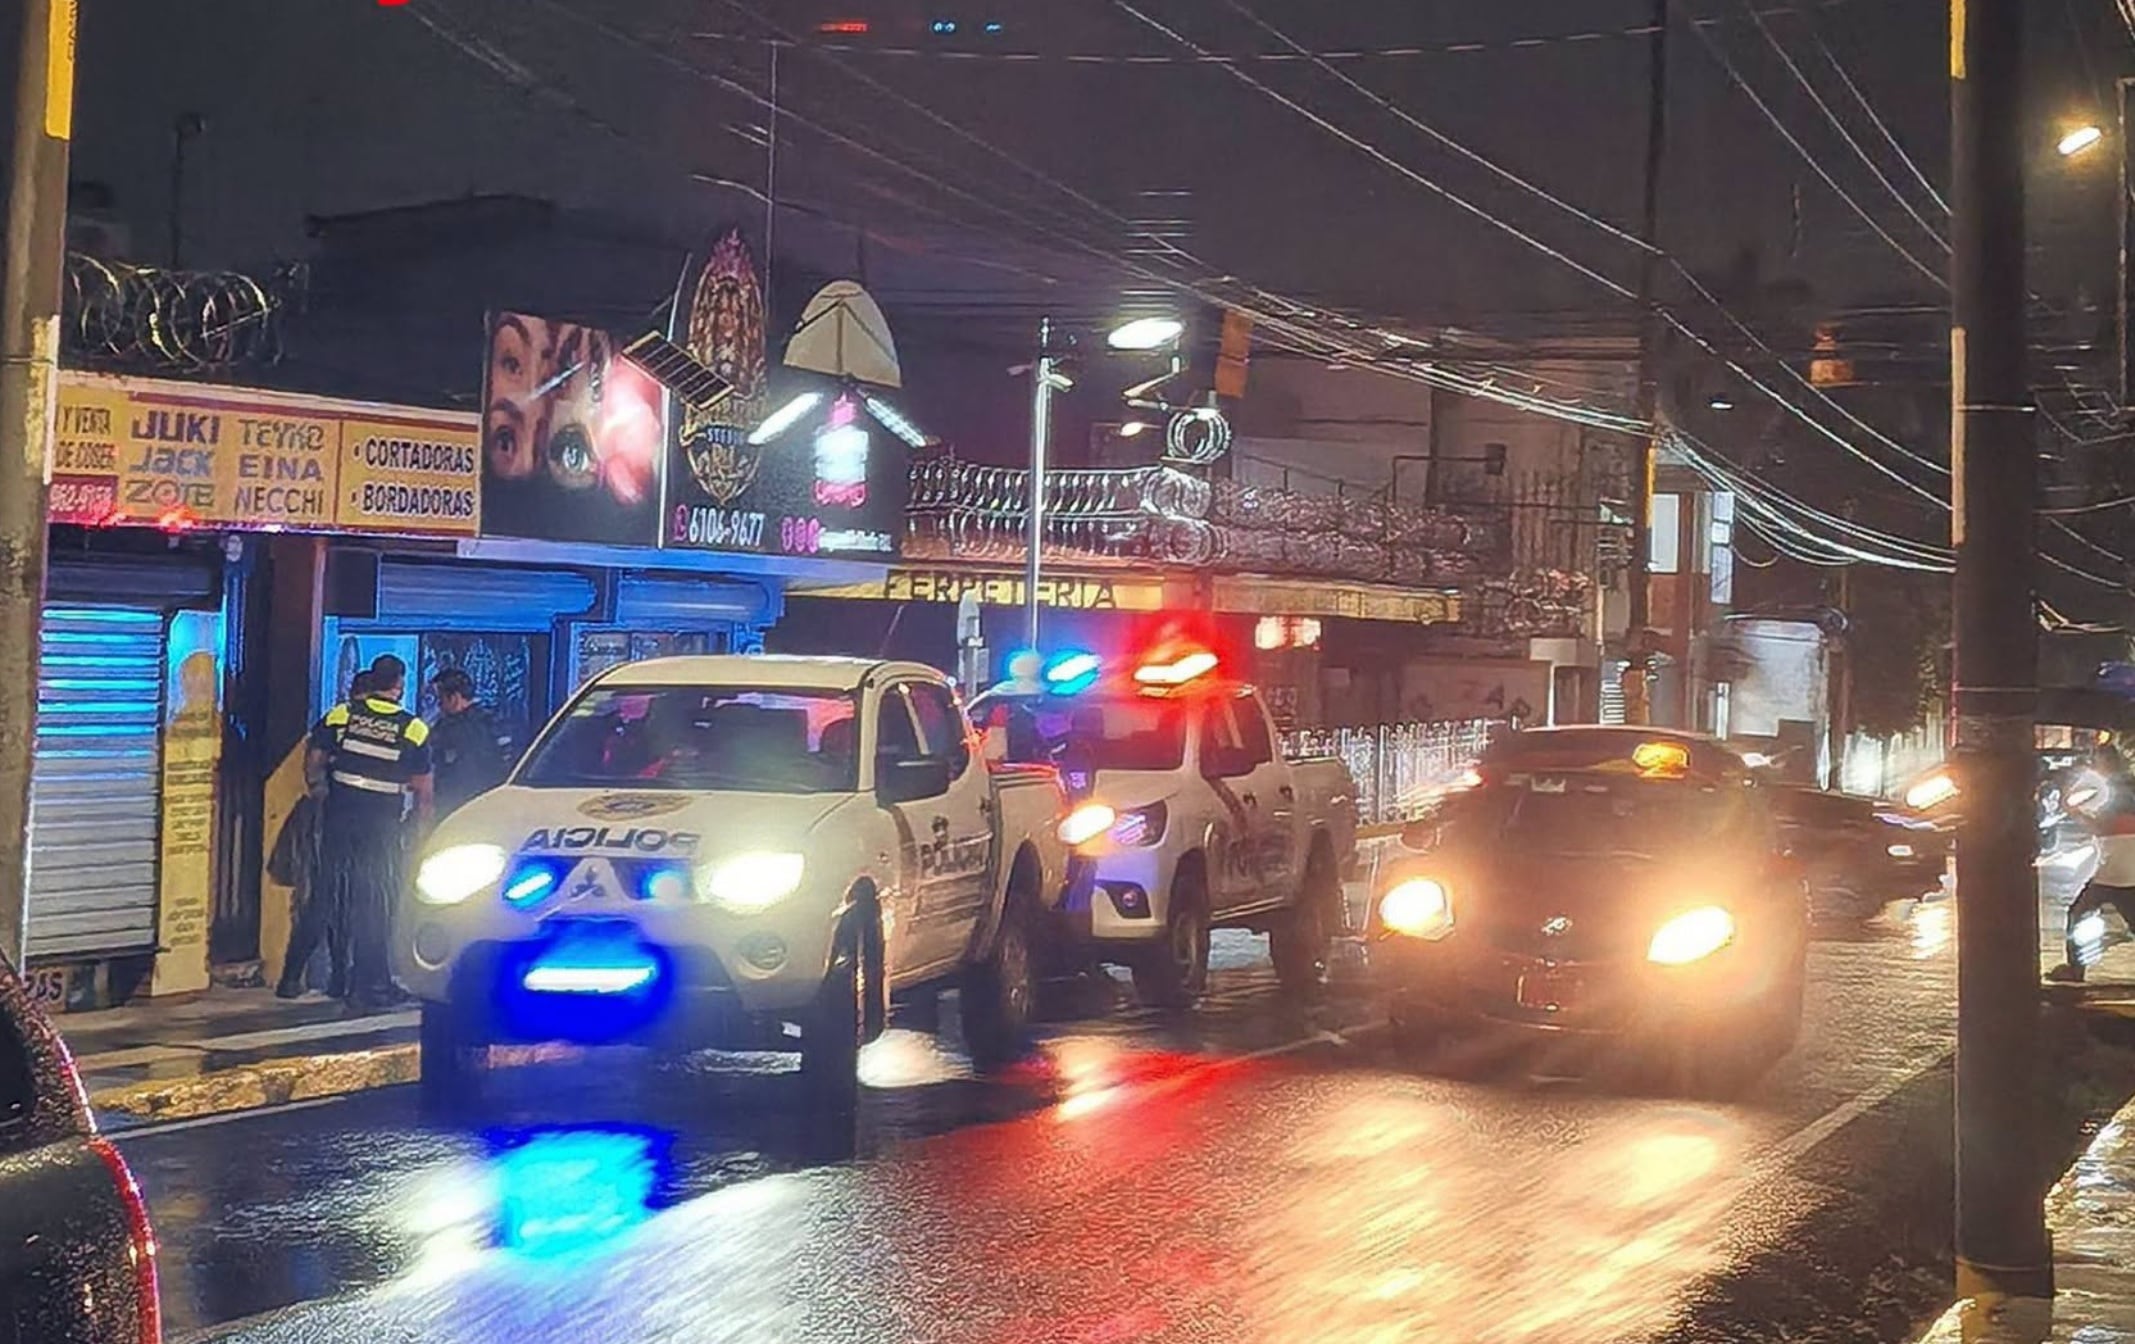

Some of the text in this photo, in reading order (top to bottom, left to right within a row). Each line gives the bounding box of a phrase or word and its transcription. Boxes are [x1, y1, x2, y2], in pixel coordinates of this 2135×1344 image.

[131, 410, 220, 444] JUKI
[239, 453, 324, 482] EINA
[365, 438, 475, 474] CORTADORAS
[234, 486, 323, 515] NECCHI
[362, 484, 475, 517] BORDADORAS
